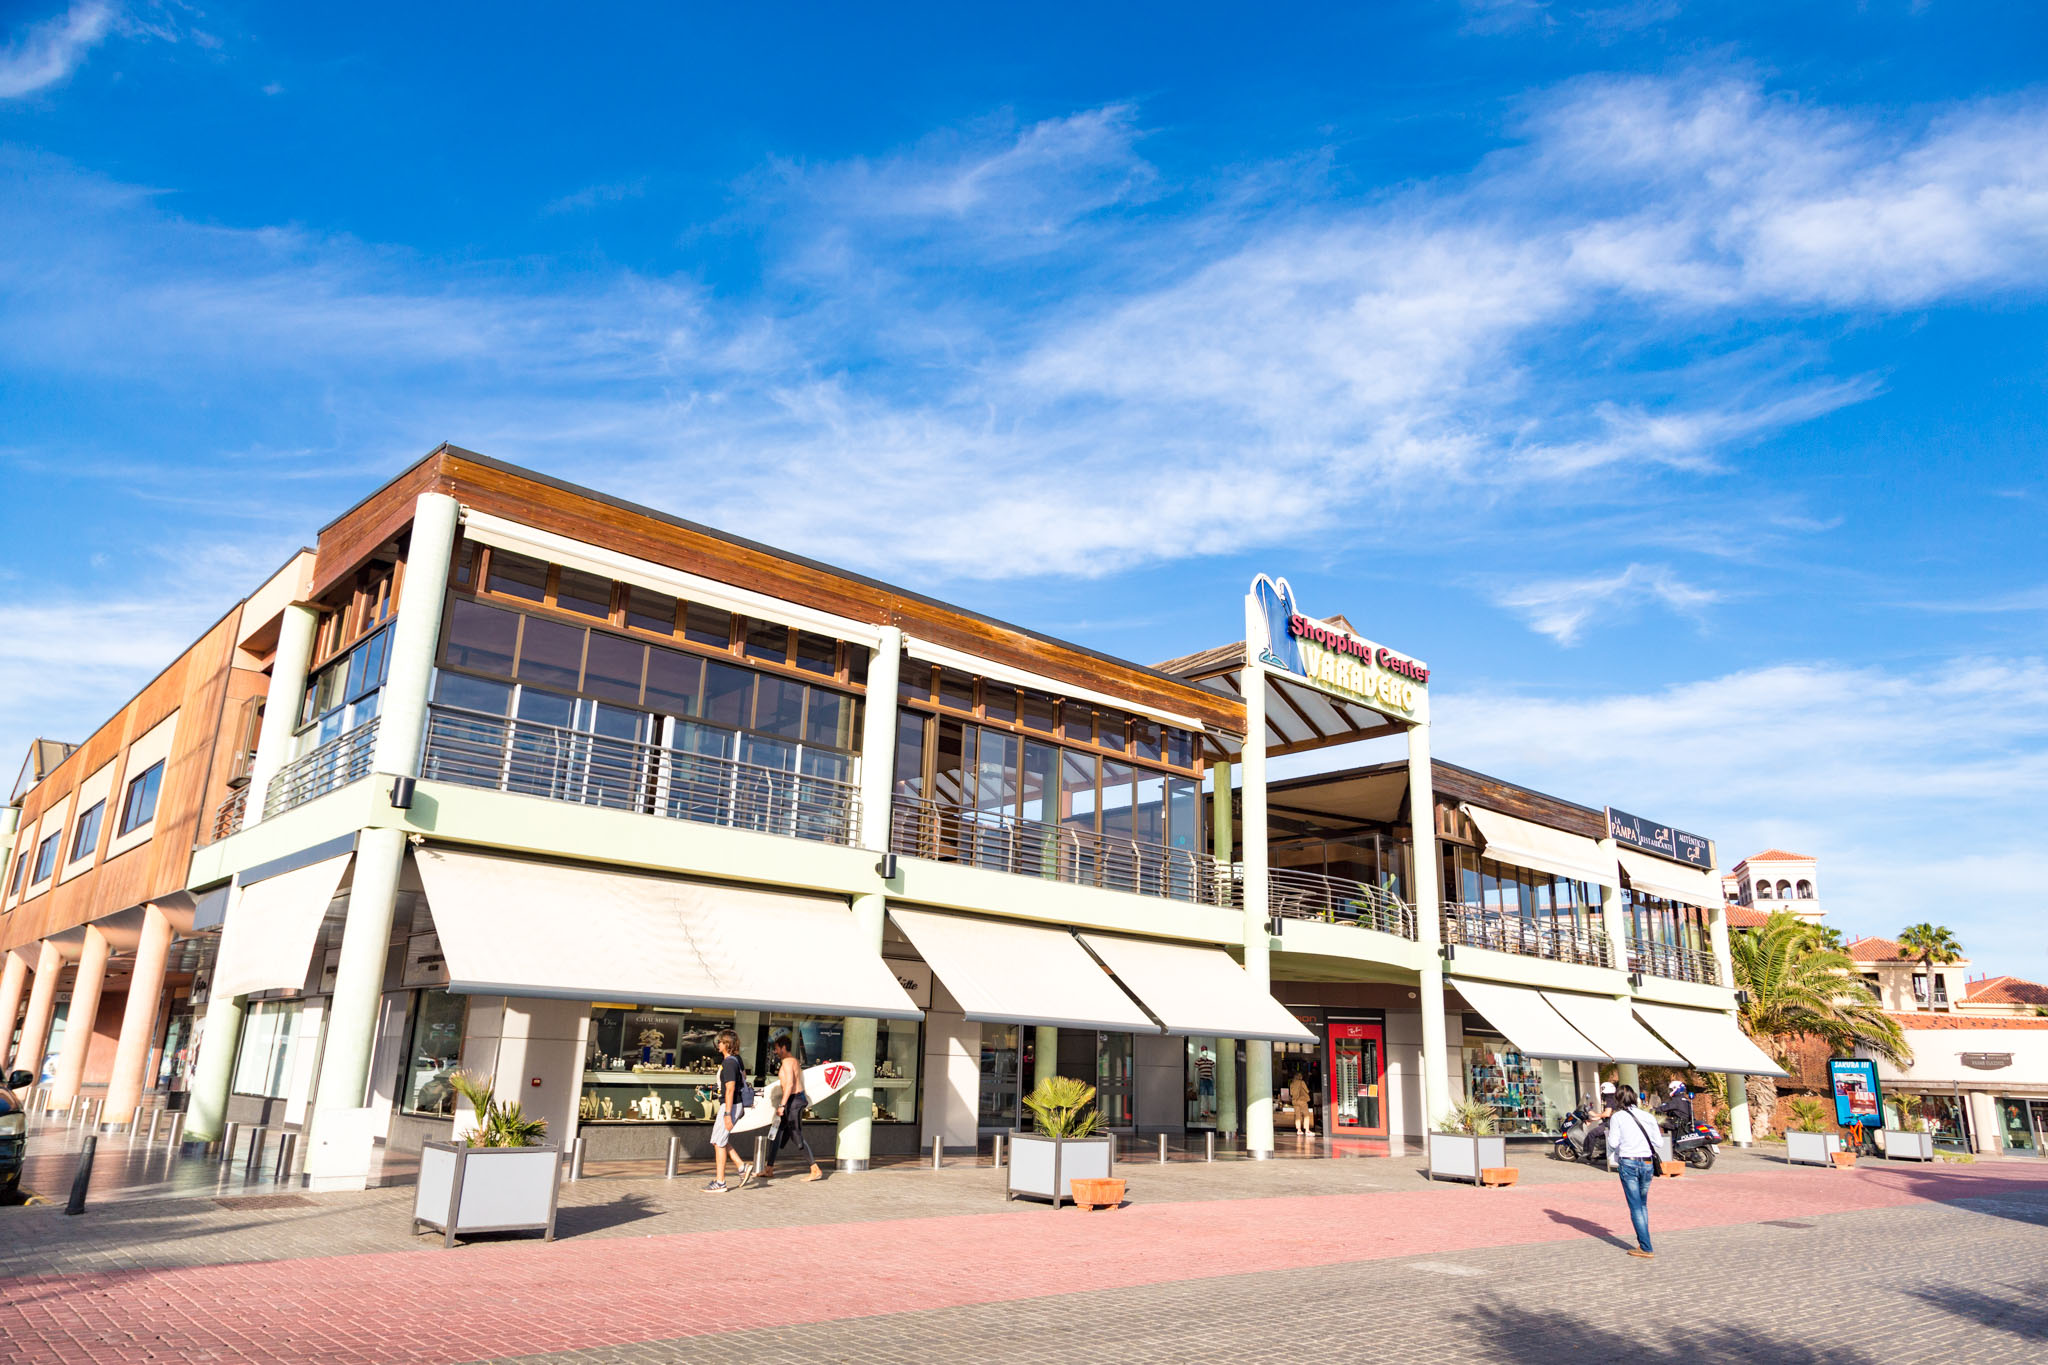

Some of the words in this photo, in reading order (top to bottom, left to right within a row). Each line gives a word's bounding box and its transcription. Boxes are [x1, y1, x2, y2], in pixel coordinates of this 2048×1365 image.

[1289, 615, 1372, 666] Shopping
[1375, 648, 1430, 684] Center
[1304, 646, 1416, 711] VARADERO
[1612, 823, 1637, 841] PAMPA
